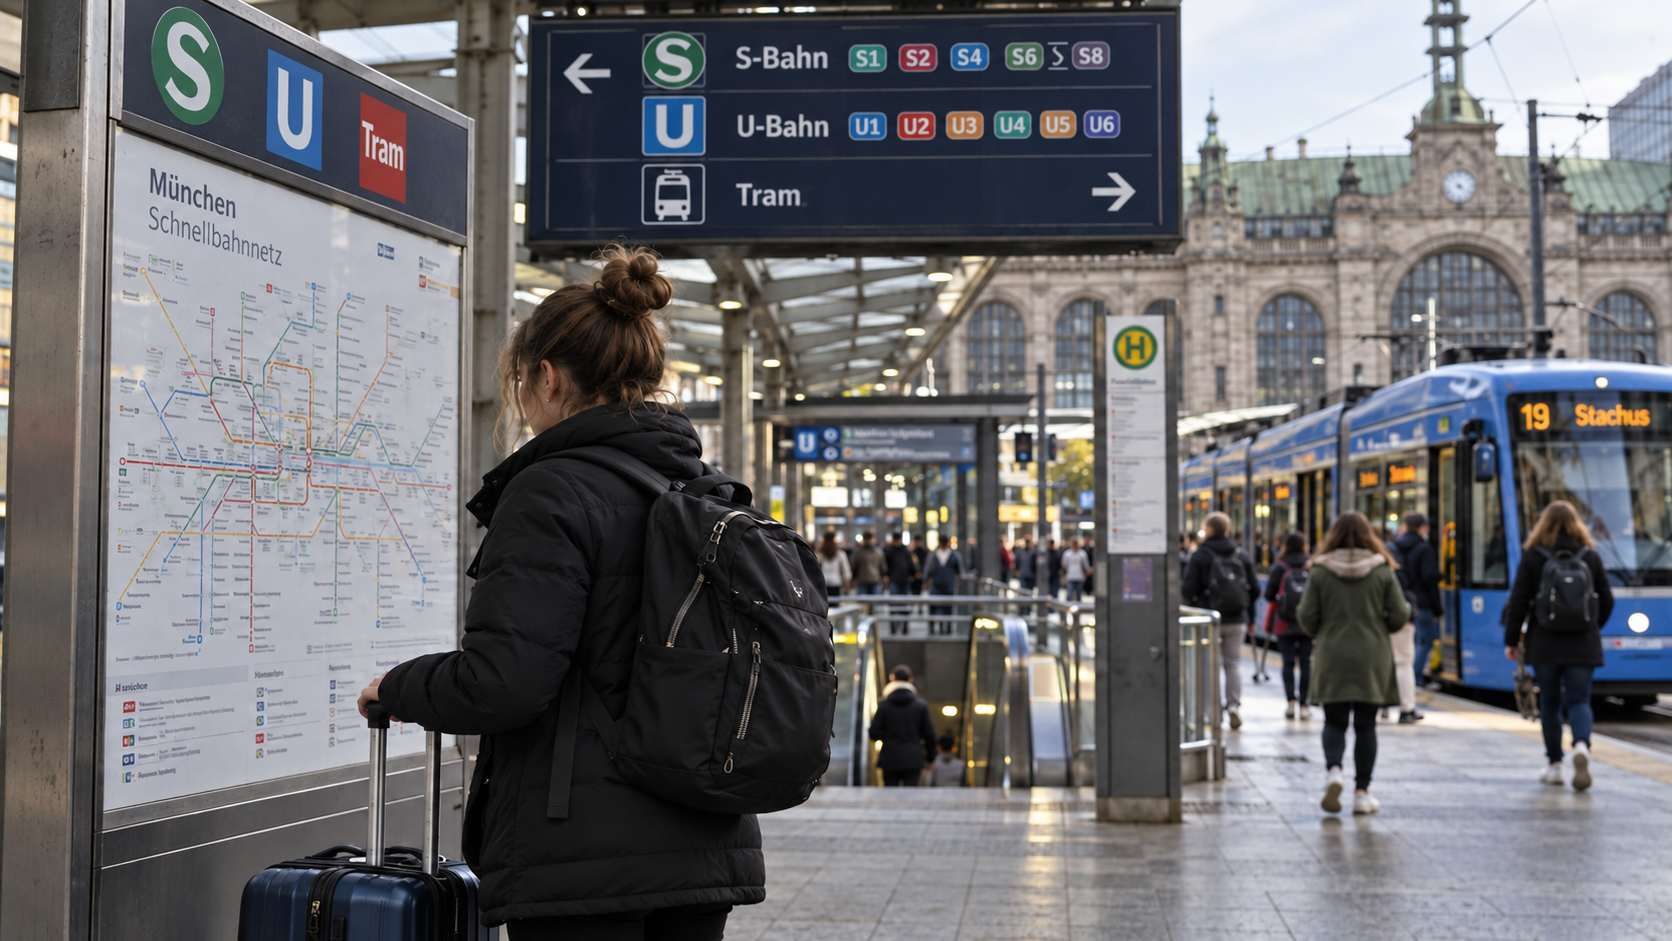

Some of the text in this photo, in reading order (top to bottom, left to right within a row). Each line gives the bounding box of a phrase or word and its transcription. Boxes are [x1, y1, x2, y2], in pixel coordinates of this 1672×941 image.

[165, 21, 212, 112] S
[654, 38, 694, 82] S
[736, 45, 828, 70] S-Bahn
[857, 50, 880, 67] S1
[907, 50, 930, 67] S2
[958, 49, 982, 66] S4
[1012, 48, 1037, 66] S6
[1079, 47, 1104, 65] S8
[277, 68, 313, 150] U
[656, 104, 1114, 148] U U-Bahn U1 U2 U3 U4 U5 U6
[361, 120, 404, 172] Tram
[150, 168, 237, 219] München
[736, 183, 801, 207] Tram
[148, 206, 283, 267] Schnellbahnnetz
[1125, 336, 1146, 360] H
[1520, 402, 1651, 431] 19 Stachus
[798, 433, 815, 453] U
